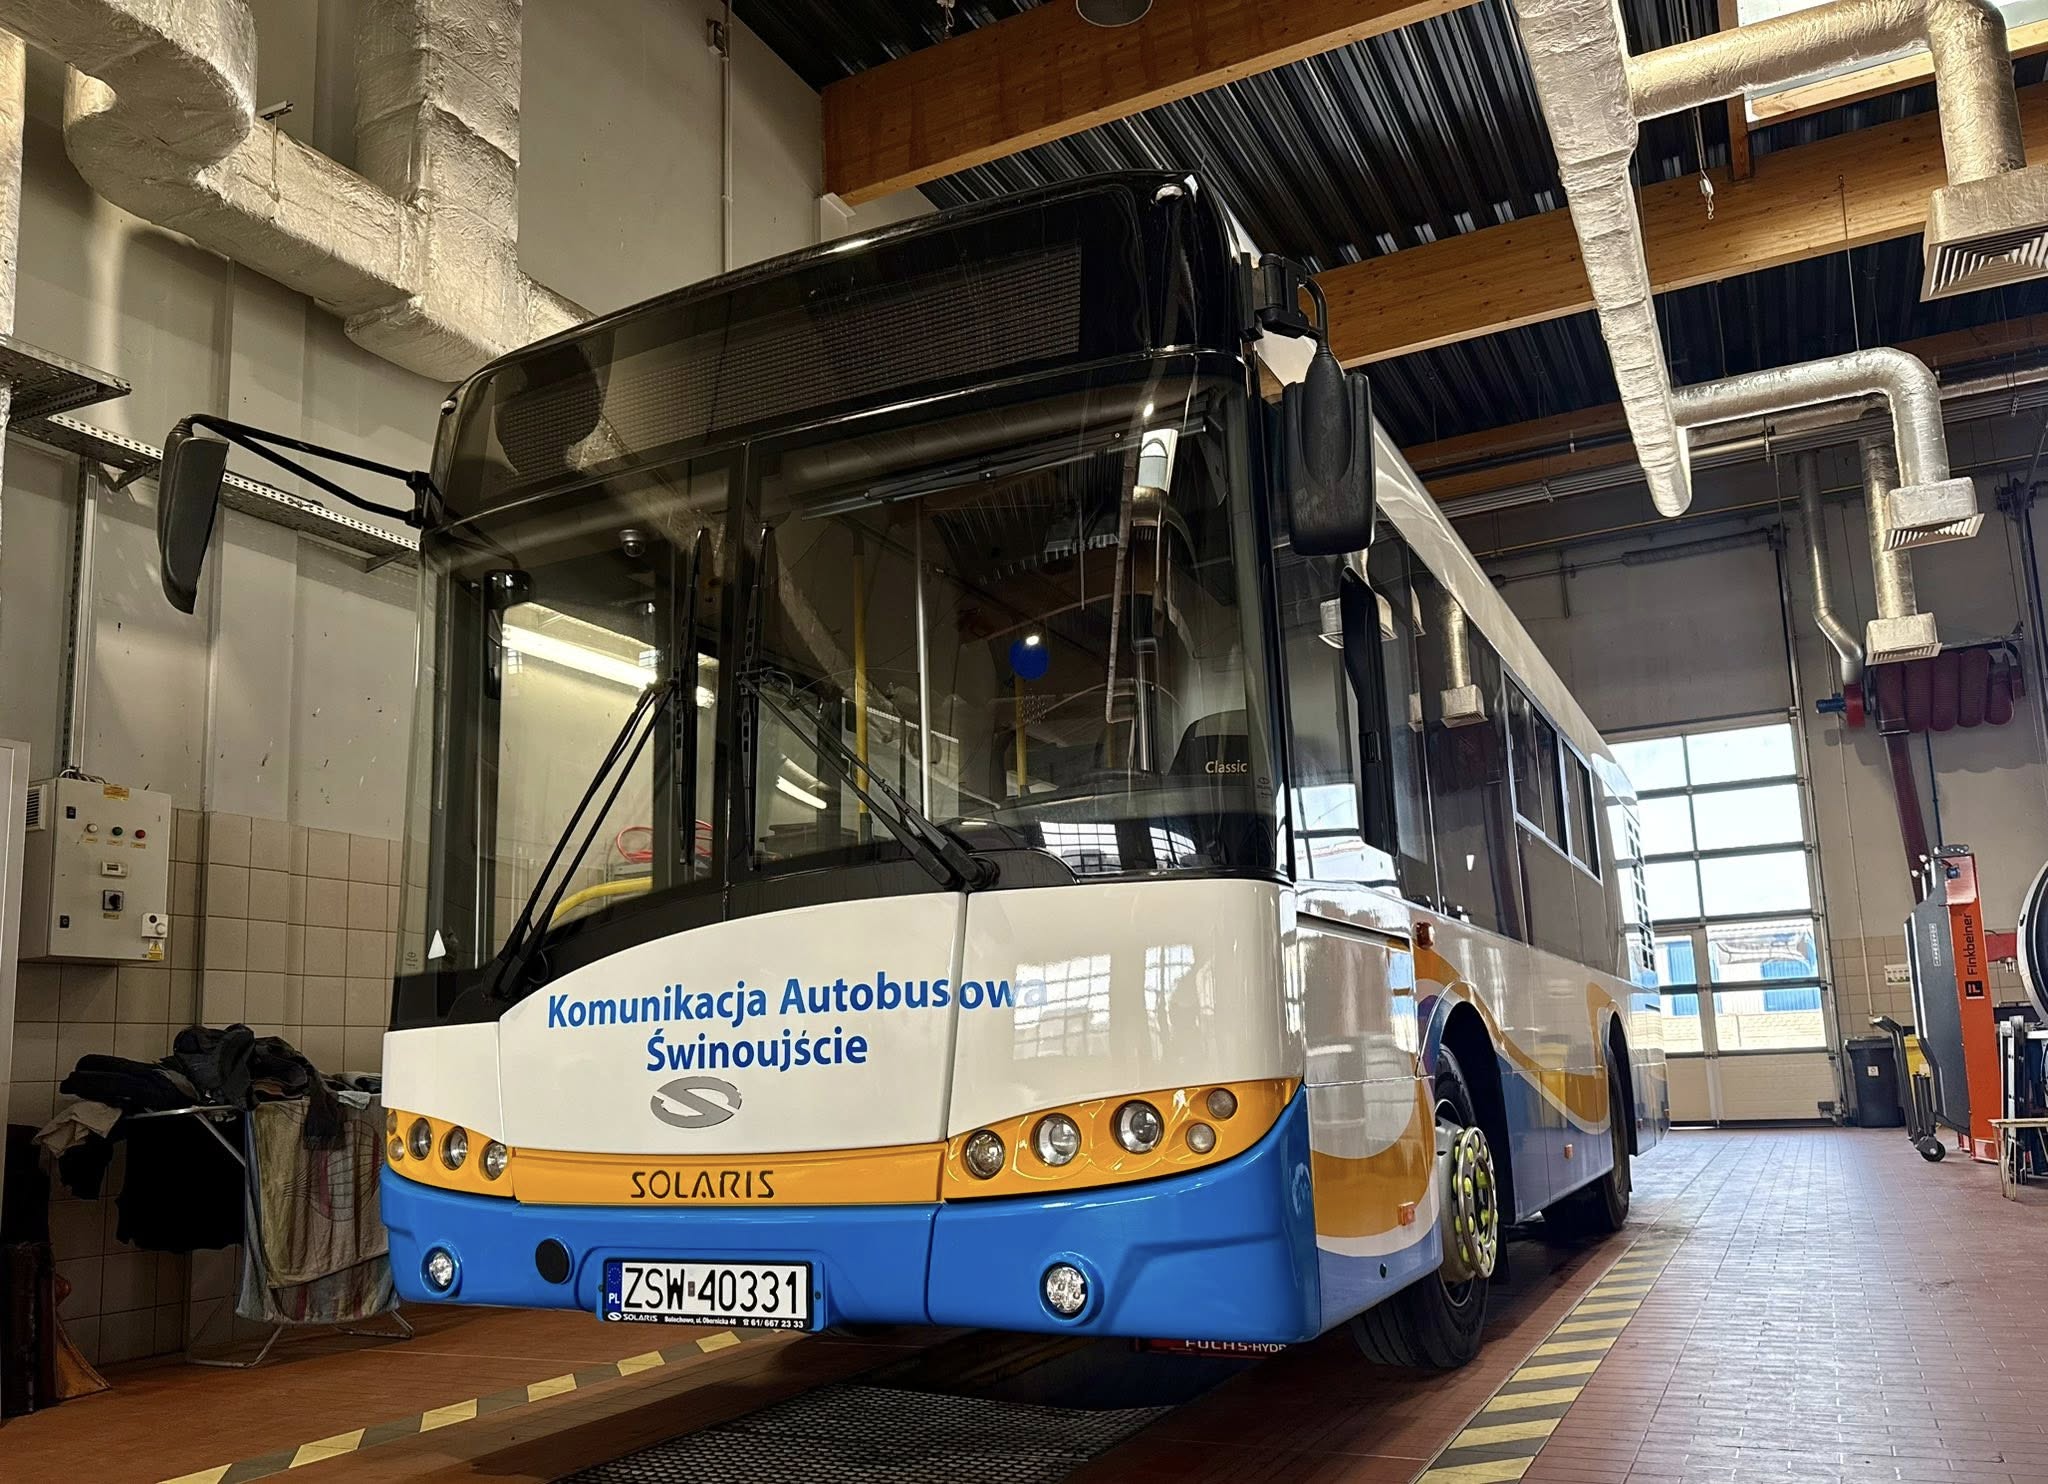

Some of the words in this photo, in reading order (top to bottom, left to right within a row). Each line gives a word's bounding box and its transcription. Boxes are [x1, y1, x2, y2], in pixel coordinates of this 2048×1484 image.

[1205, 760, 1248, 774] Classic
[1963, 913, 1977, 975] Finkbeiner
[548, 980, 766, 1029] Komunikacja
[779, 971, 1048, 1014] Autobusowa
[646, 1026, 868, 1073] Świnoujście
[630, 1169, 775, 1199] SOLARIS
[608, 1292, 620, 1304] PL
[624, 1267, 685, 1310] ZSW
[697, 1269, 797, 1314] 40331
[622, 1313, 658, 1322] SOLARIS
[781, 1320, 791, 1328] 23
[793, 1320, 804, 1328] 33
